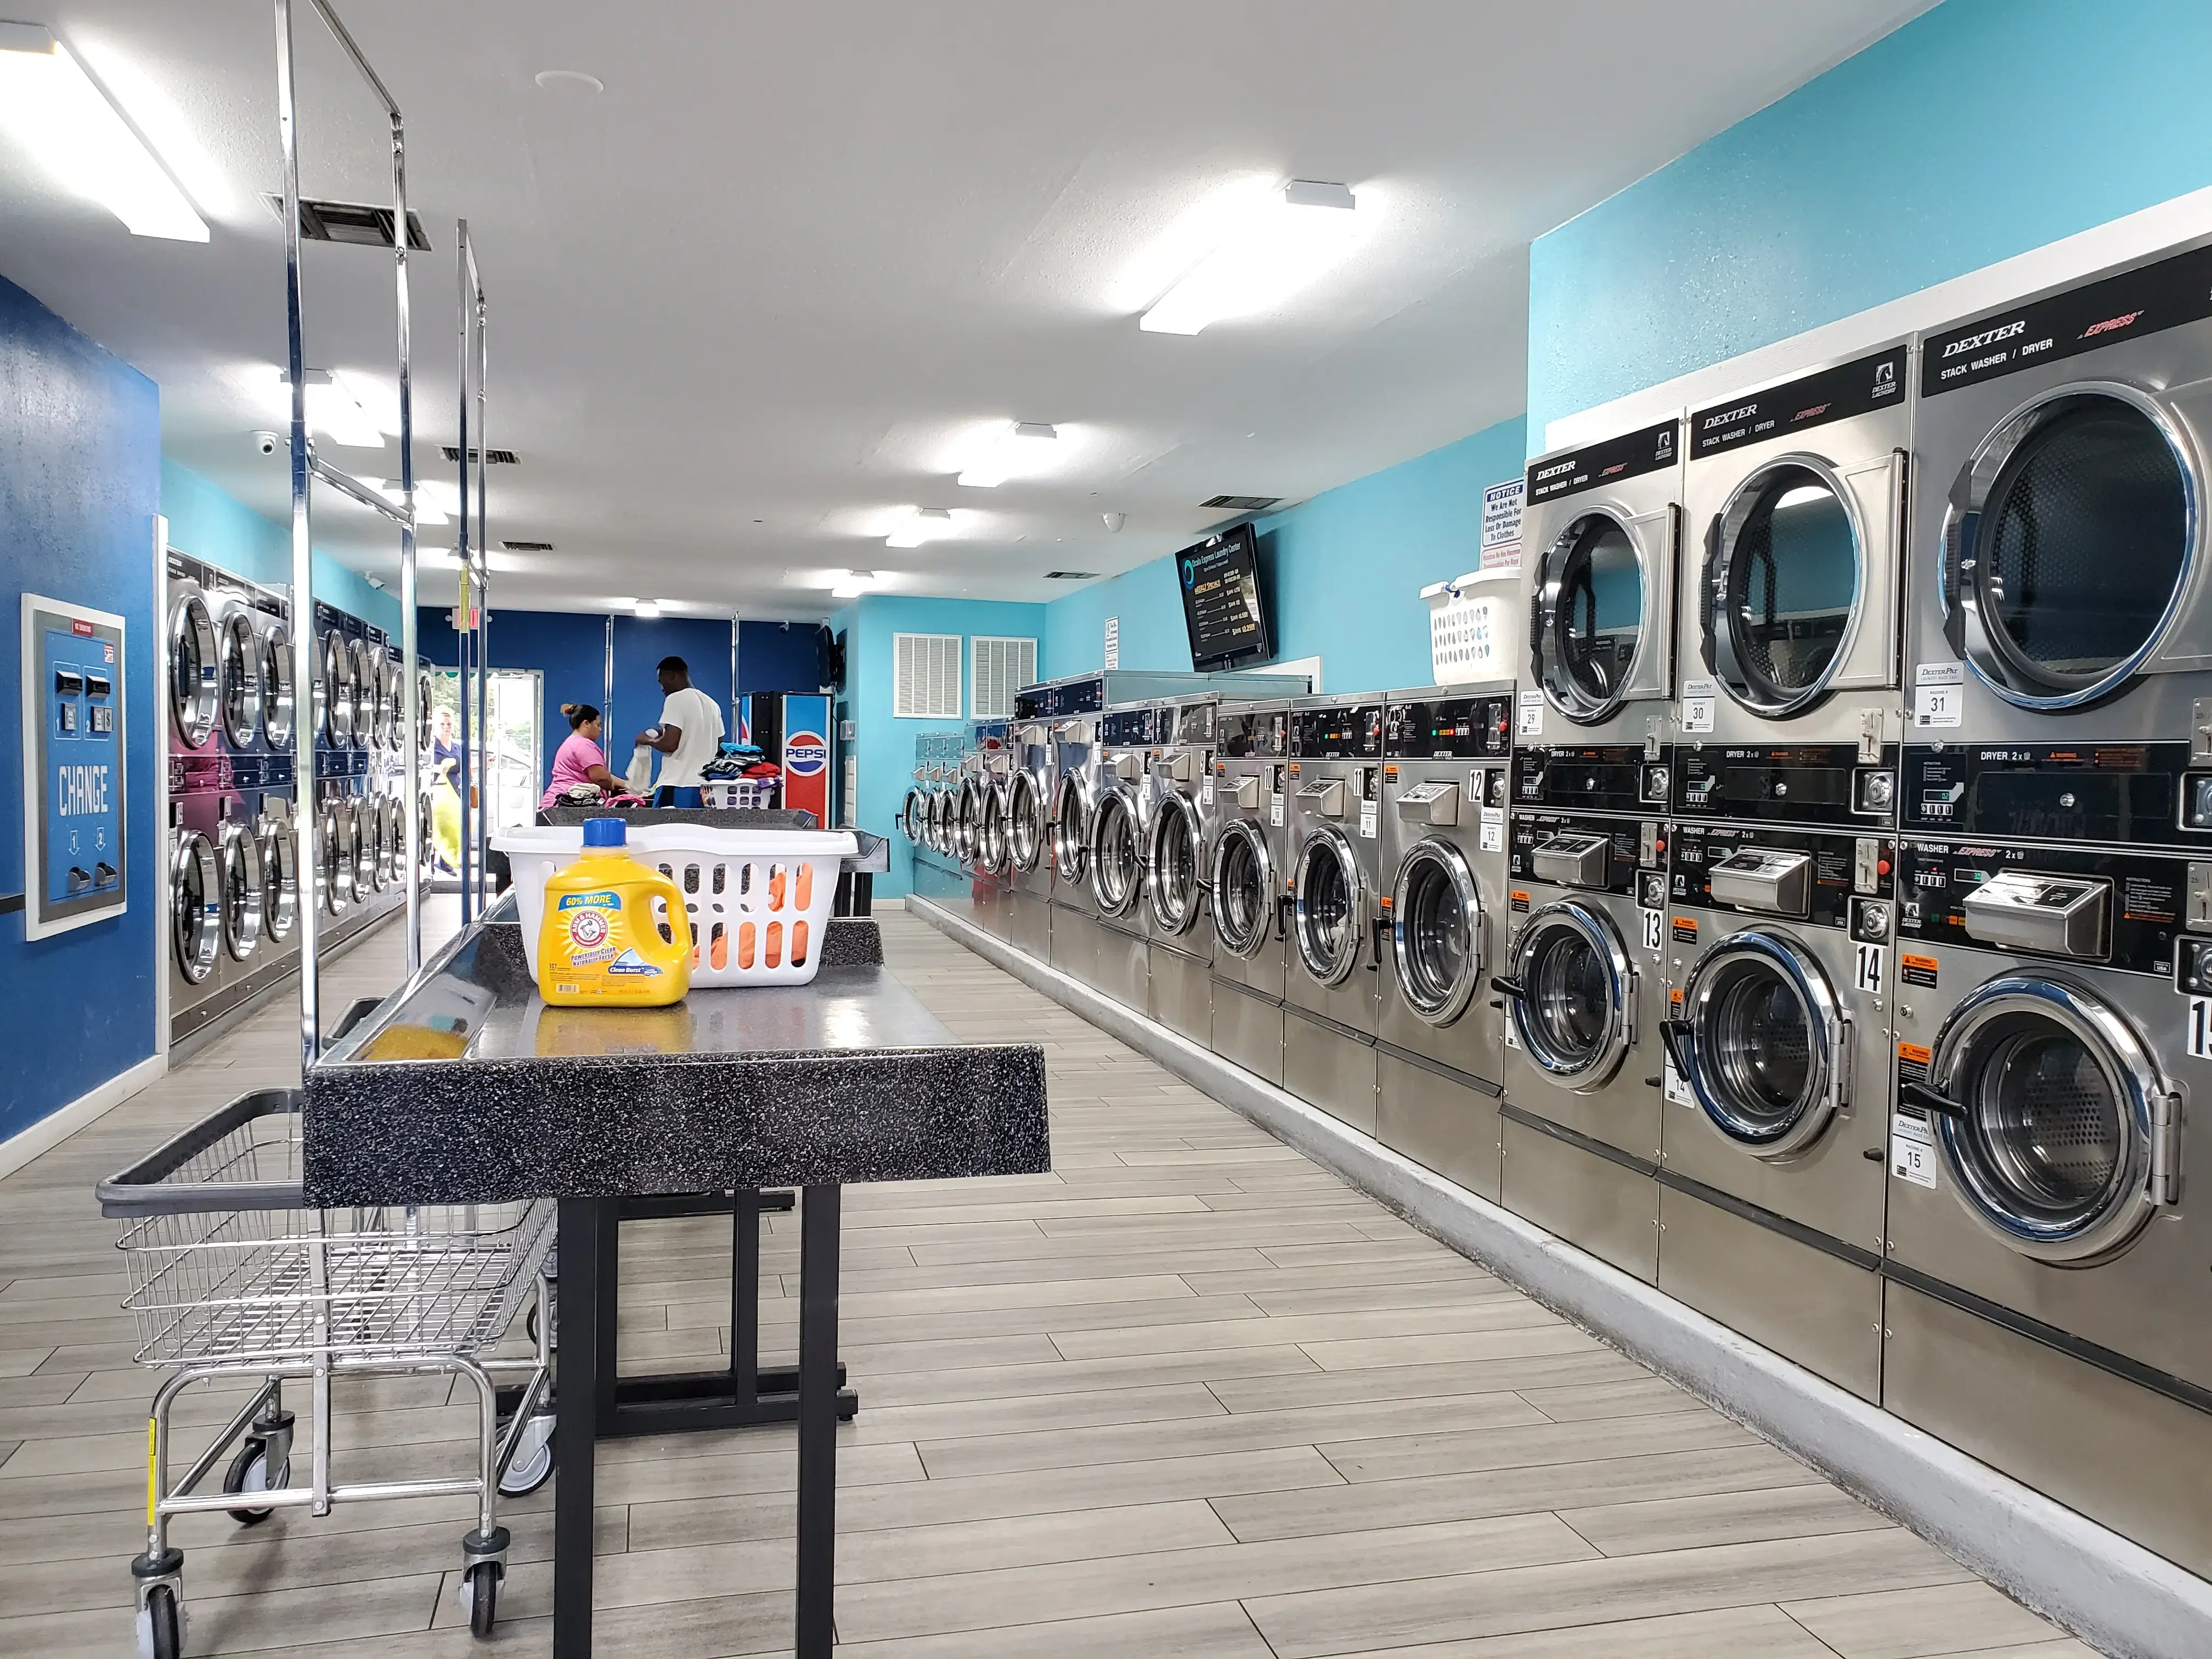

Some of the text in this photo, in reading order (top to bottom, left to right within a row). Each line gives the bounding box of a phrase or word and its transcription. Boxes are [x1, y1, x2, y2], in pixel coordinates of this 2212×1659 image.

[1942, 312, 2137, 358] DEXTER EXPRESS
[1941, 338, 2053, 380] STACK WASHER / DRYER
[1872, 381, 1897, 393] DEXTER
[1703, 404, 1827, 430] DEXTER EXPRESS
[1702, 436, 1719, 447] STACK
[1722, 428, 1745, 442] WASHER
[1755, 420, 1775, 433] DRYER
[1655, 447, 1672, 456] DEXTER
[1536, 460, 1576, 481] DEXTER
[1536, 486, 1549, 496] STACK
[1550, 481, 1567, 492] WASHER
[1573, 475, 1588, 485] DRYER
[1490, 486, 1520, 501] NOTICE
[1491, 504, 1498, 512] We
[1486, 511, 1513, 523] Responsible
[1485, 524, 1494, 533] Loss
[1503, 518, 1521, 529] Damage
[1491, 530, 1514, 541] To Clothes
[1192, 557, 1201, 567] Ocala
[1201, 554, 1215, 565] Express
[1215, 547, 1228, 559] Laundry
[1229, 543, 1240, 553] Center
[1931, 697, 1944, 712] 31
[1527, 714, 1535, 724] 29
[1693, 707, 1703, 719] 30
[56, 718, 60, 731] 1
[86, 720, 90, 733] 2
[786, 748, 826, 759] PEPSI
[1980, 752, 2008, 760] DRYER
[1200, 752, 1204, 771] 9
[1266, 767, 1272, 789] 10
[1355, 769, 1362, 794] 11
[1471, 771, 1482, 800] 12
[59, 765, 108, 816] CHANGE
[177, 803, 183, 822] 19
[1365, 820, 1370, 829] 11
[1683, 827, 1705, 835] WASHER
[72, 835, 75, 849] 1
[99, 832, 103, 845] 2
[1488, 831, 1495, 841] 12
[1917, 843, 1949, 854] WASHER
[1957, 847, 1996, 857] EXPRESS
[567, 895, 612, 906] 60% MORE
[572, 917, 580, 933] ARM
[585, 912, 606, 933] HAMMER
[1645, 911, 1661, 947] 13
[571, 951, 600, 961] POWERFULLY
[573, 957, 599, 966] NATURALLY
[1857, 946, 1880, 991] 14
[2192, 1001, 2212, 1056] 1
[1675, 1079, 1685, 1092] 14
[1898, 1120, 1929, 1135] DEXTERPA
[1908, 1152, 1921, 1169] 15
